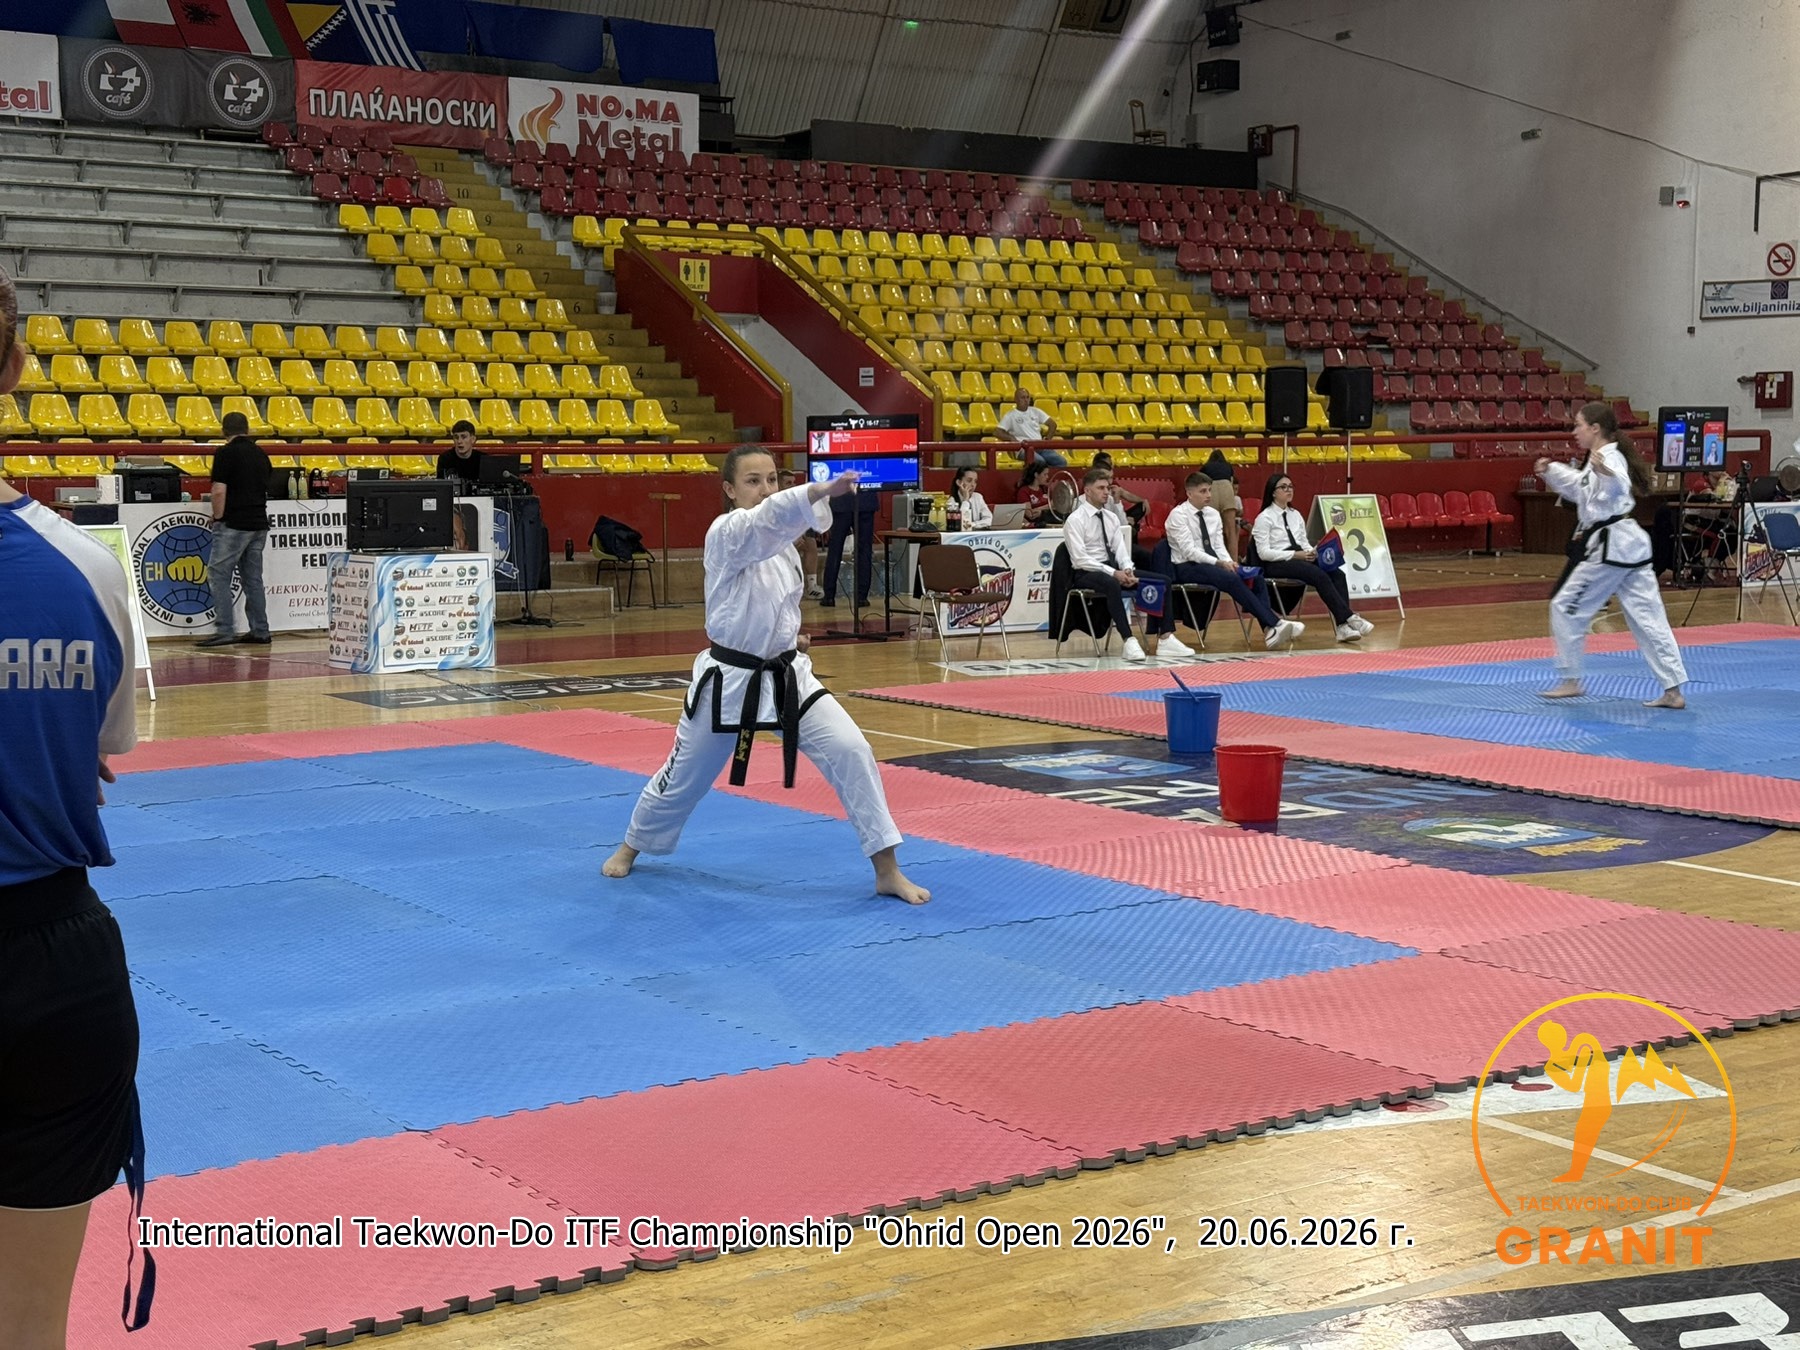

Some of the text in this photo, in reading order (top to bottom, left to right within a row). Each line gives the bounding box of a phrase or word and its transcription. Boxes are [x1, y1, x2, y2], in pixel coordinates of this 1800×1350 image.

[105, 94, 131, 105] café
[227, 103, 252, 115] café
[308, 86, 497, 130] ПЛАЌАНОСКИ
[433, 162, 445, 173] 11
[456, 187, 470, 199] 10
[484, 214, 492, 226] 9
[516, 243, 523, 253] 8
[543, 271, 550, 285] 7
[573, 302, 581, 314] 6
[607, 334, 615, 346] 5
[636, 365, 644, 379] 4
[671, 400, 679, 413] 3
[968, 536, 993, 547] Ohrid
[1347, 528, 1371, 571] 3
[0, 638, 94, 690] ARA
